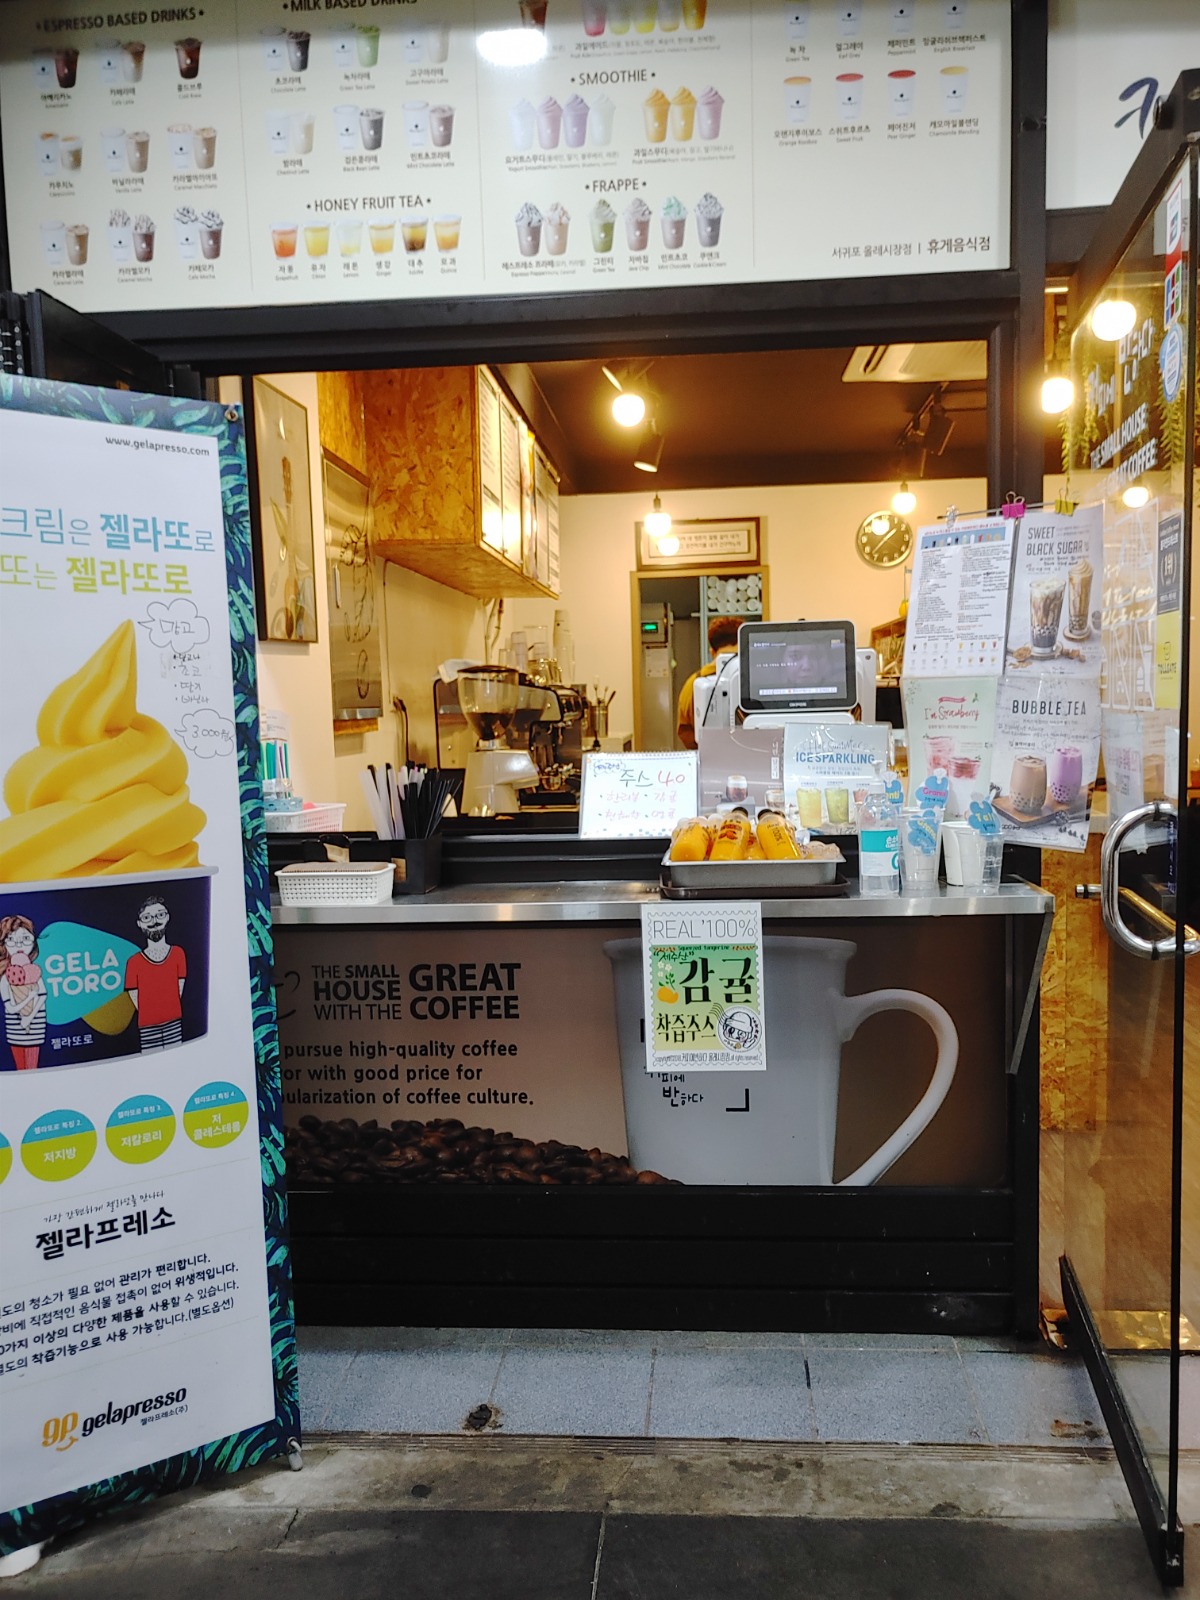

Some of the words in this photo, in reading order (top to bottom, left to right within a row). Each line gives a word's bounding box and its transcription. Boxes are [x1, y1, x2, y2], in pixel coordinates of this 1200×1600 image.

[291, 0, 321, 12] MILK
[44, 17, 103, 32] ESPRESSO
[108, 12, 147, 27] BASED
[152, 7, 196, 22] DRINKS
[579, 70, 647, 85] SMOOTHIE
[592, 178, 640, 192] FRAPPE
[315, 198, 358, 212] HONEY
[363, 196, 395, 210] FRUIT
[400, 195, 424, 208] TEA
[832, 246, 861, 259] 서귀포
[864, 243, 912, 258] 올레시장점
[927, 236, 991, 254] 휴게음식점
[1121, 402, 1148, 448] HOUSE
[105, 435, 210, 457] www.gelapresso.com
[1127, 438, 1158, 482] COFFEE
[0, 507, 92, 546] 크림은
[100, 513, 216, 552] 젤라또로
[1028, 526, 1056, 540] SWEET
[1026, 542, 1054, 556] BLACK
[1056, 540, 1083, 554] SUGAR
[0, 554, 58, 590] 또는
[66, 556, 192, 595] 젤라또로
[1012, 700, 1062, 716] BUBBLE
[1067, 701, 1086, 716] TEA
[796, 752, 813, 762] ICE
[815, 752, 876, 764] SPARKLING
[620, 769, 654, 788] 주스
[45, 948, 120, 974] GELA
[312, 964, 340, 979] THE
[345, 964, 400, 978] SMALL
[46, 970, 122, 998] TORO
[408, 962, 522, 992] GREAT
[314, 980, 402, 1001] HOUSE
[314, 1004, 362, 1020] WITH
[367, 1004, 402, 1020] THE
[409, 996, 520, 1020] COFFEE
[656, 1012, 717, 1044] 착즙주스
[51, 1034, 94, 1050] 젤라또로
[284, 1044, 342, 1060] pursue
[350, 1040, 455, 1060] high-quality
[462, 1040, 518, 1056] coffee
[308, 1064, 346, 1080] with
[354, 1064, 400, 1084] good
[406, 1066, 450, 1084] price
[456, 1064, 483, 1080] for
[382, 1088, 402, 1104] of
[406, 1088, 462, 1104] coffee
[466, 1088, 534, 1106] culture.
[212, 1113, 222, 1124] 저
[121, 1132, 162, 1148] 저칼로리
[193, 1120, 241, 1140] 콜레스테롤
[44, 1147, 77, 1163] 저지방
[35, 1206, 176, 1261] 젤라프레소
[0, 1300, 25, 1320] 도의
[29, 1291, 64, 1310] 청소가
[68, 1285, 90, 1300] 필요
[94, 1278, 116, 1294] 없어
[119, 1268, 152, 1287] 관리가
[156, 1253, 210, 1277] 편리합니다.
[30, 1306, 76, 1326] 직접적인
[79, 1295, 113, 1316] 음식물
[116, 1286, 148, 1305] 접촉이
[150, 1280, 172, 1296] 없어
[174, 1262, 239, 1288] 위생적입니다.
[33, 1326, 68, 1344] 이상의
[72, 1316, 108, 1334] 다양한
[112, 1306, 145, 1324] 제품을
[148, 1296, 180, 1313] 사용할
[184, 1292, 194, 1304] 수
[197, 1280, 240, 1300] 있습니다.
[32, 1336, 102, 1364] 착즙기능으로
[106, 1328, 129, 1342] 사용
[82, 1388, 187, 1437] gelapresso
[140, 1404, 189, 1426] 젤라프레소(주)
